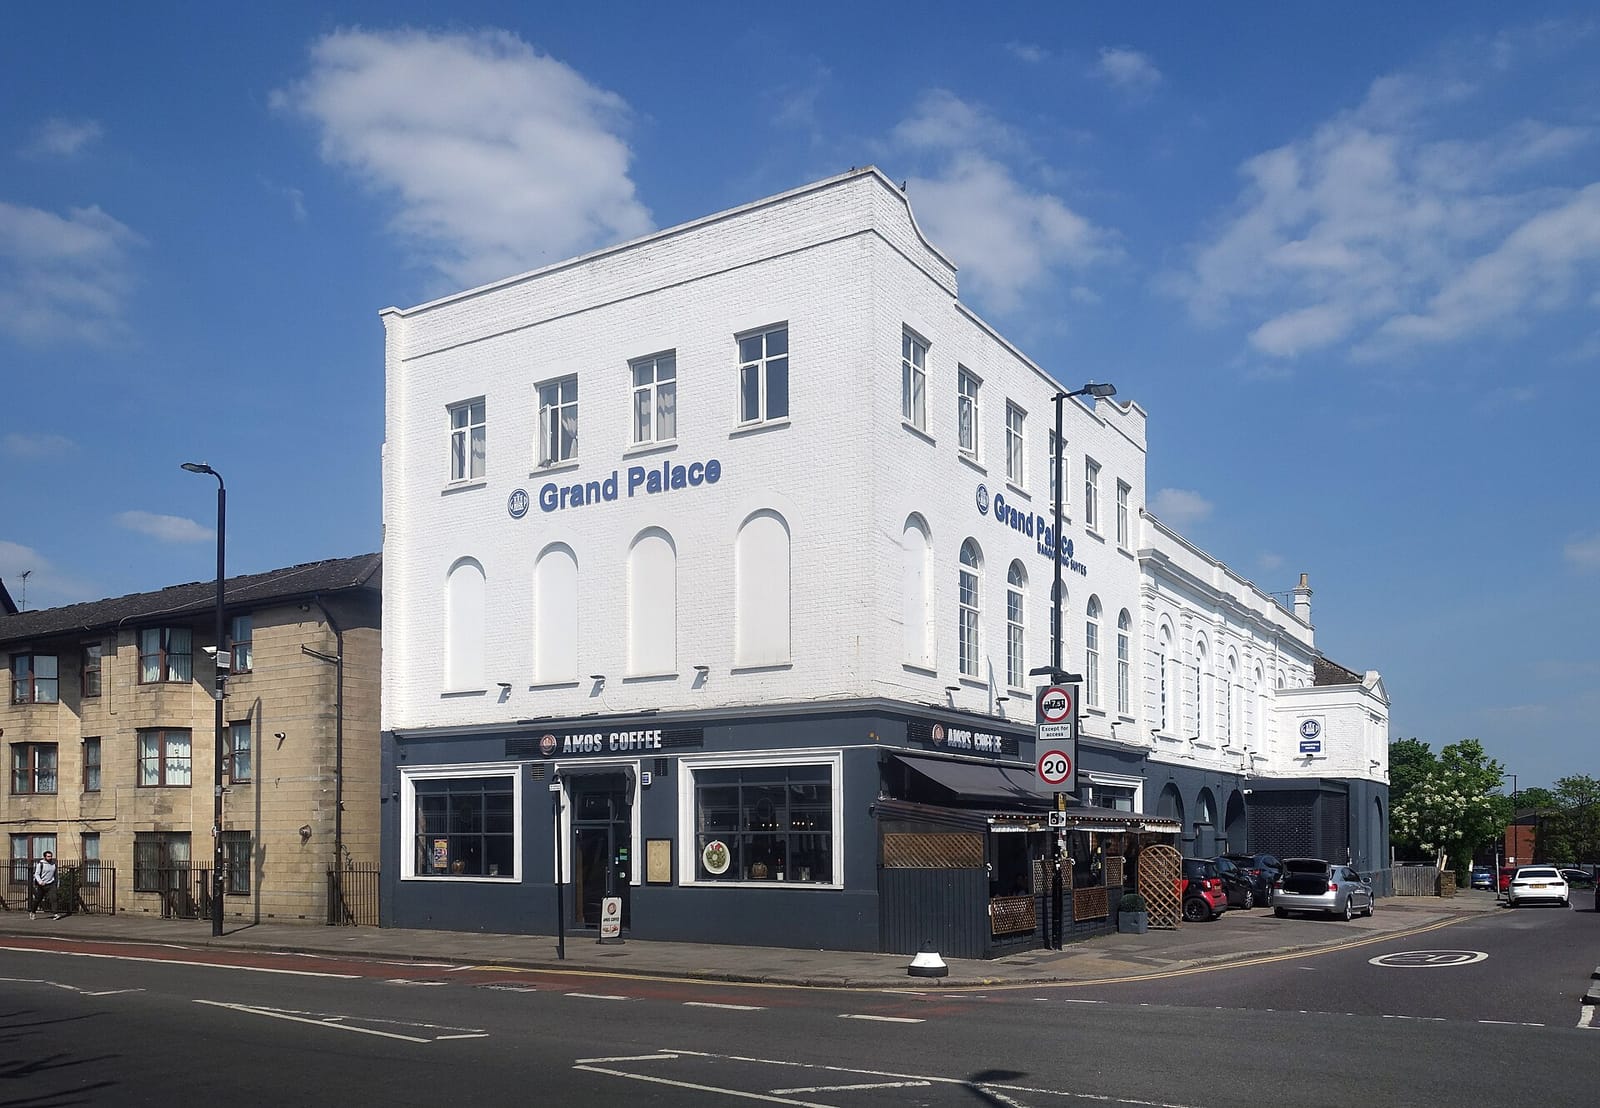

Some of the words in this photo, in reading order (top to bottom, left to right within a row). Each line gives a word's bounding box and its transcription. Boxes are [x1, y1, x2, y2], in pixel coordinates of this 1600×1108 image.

[539, 470, 618, 513] Grand
[628, 459, 721, 498] Palace
[993, 493, 1034, 538] Grand
[1036, 515, 1074, 559] Palce
[562, 733, 602, 753] AMOS
[609, 730, 662, 751] COFFEE
[948, 728, 972, 750] AMOS
[974, 732, 1002, 753] COFFEE
[1044, 761, 1067, 774] 20
[1383, 953, 1471, 963] 20
